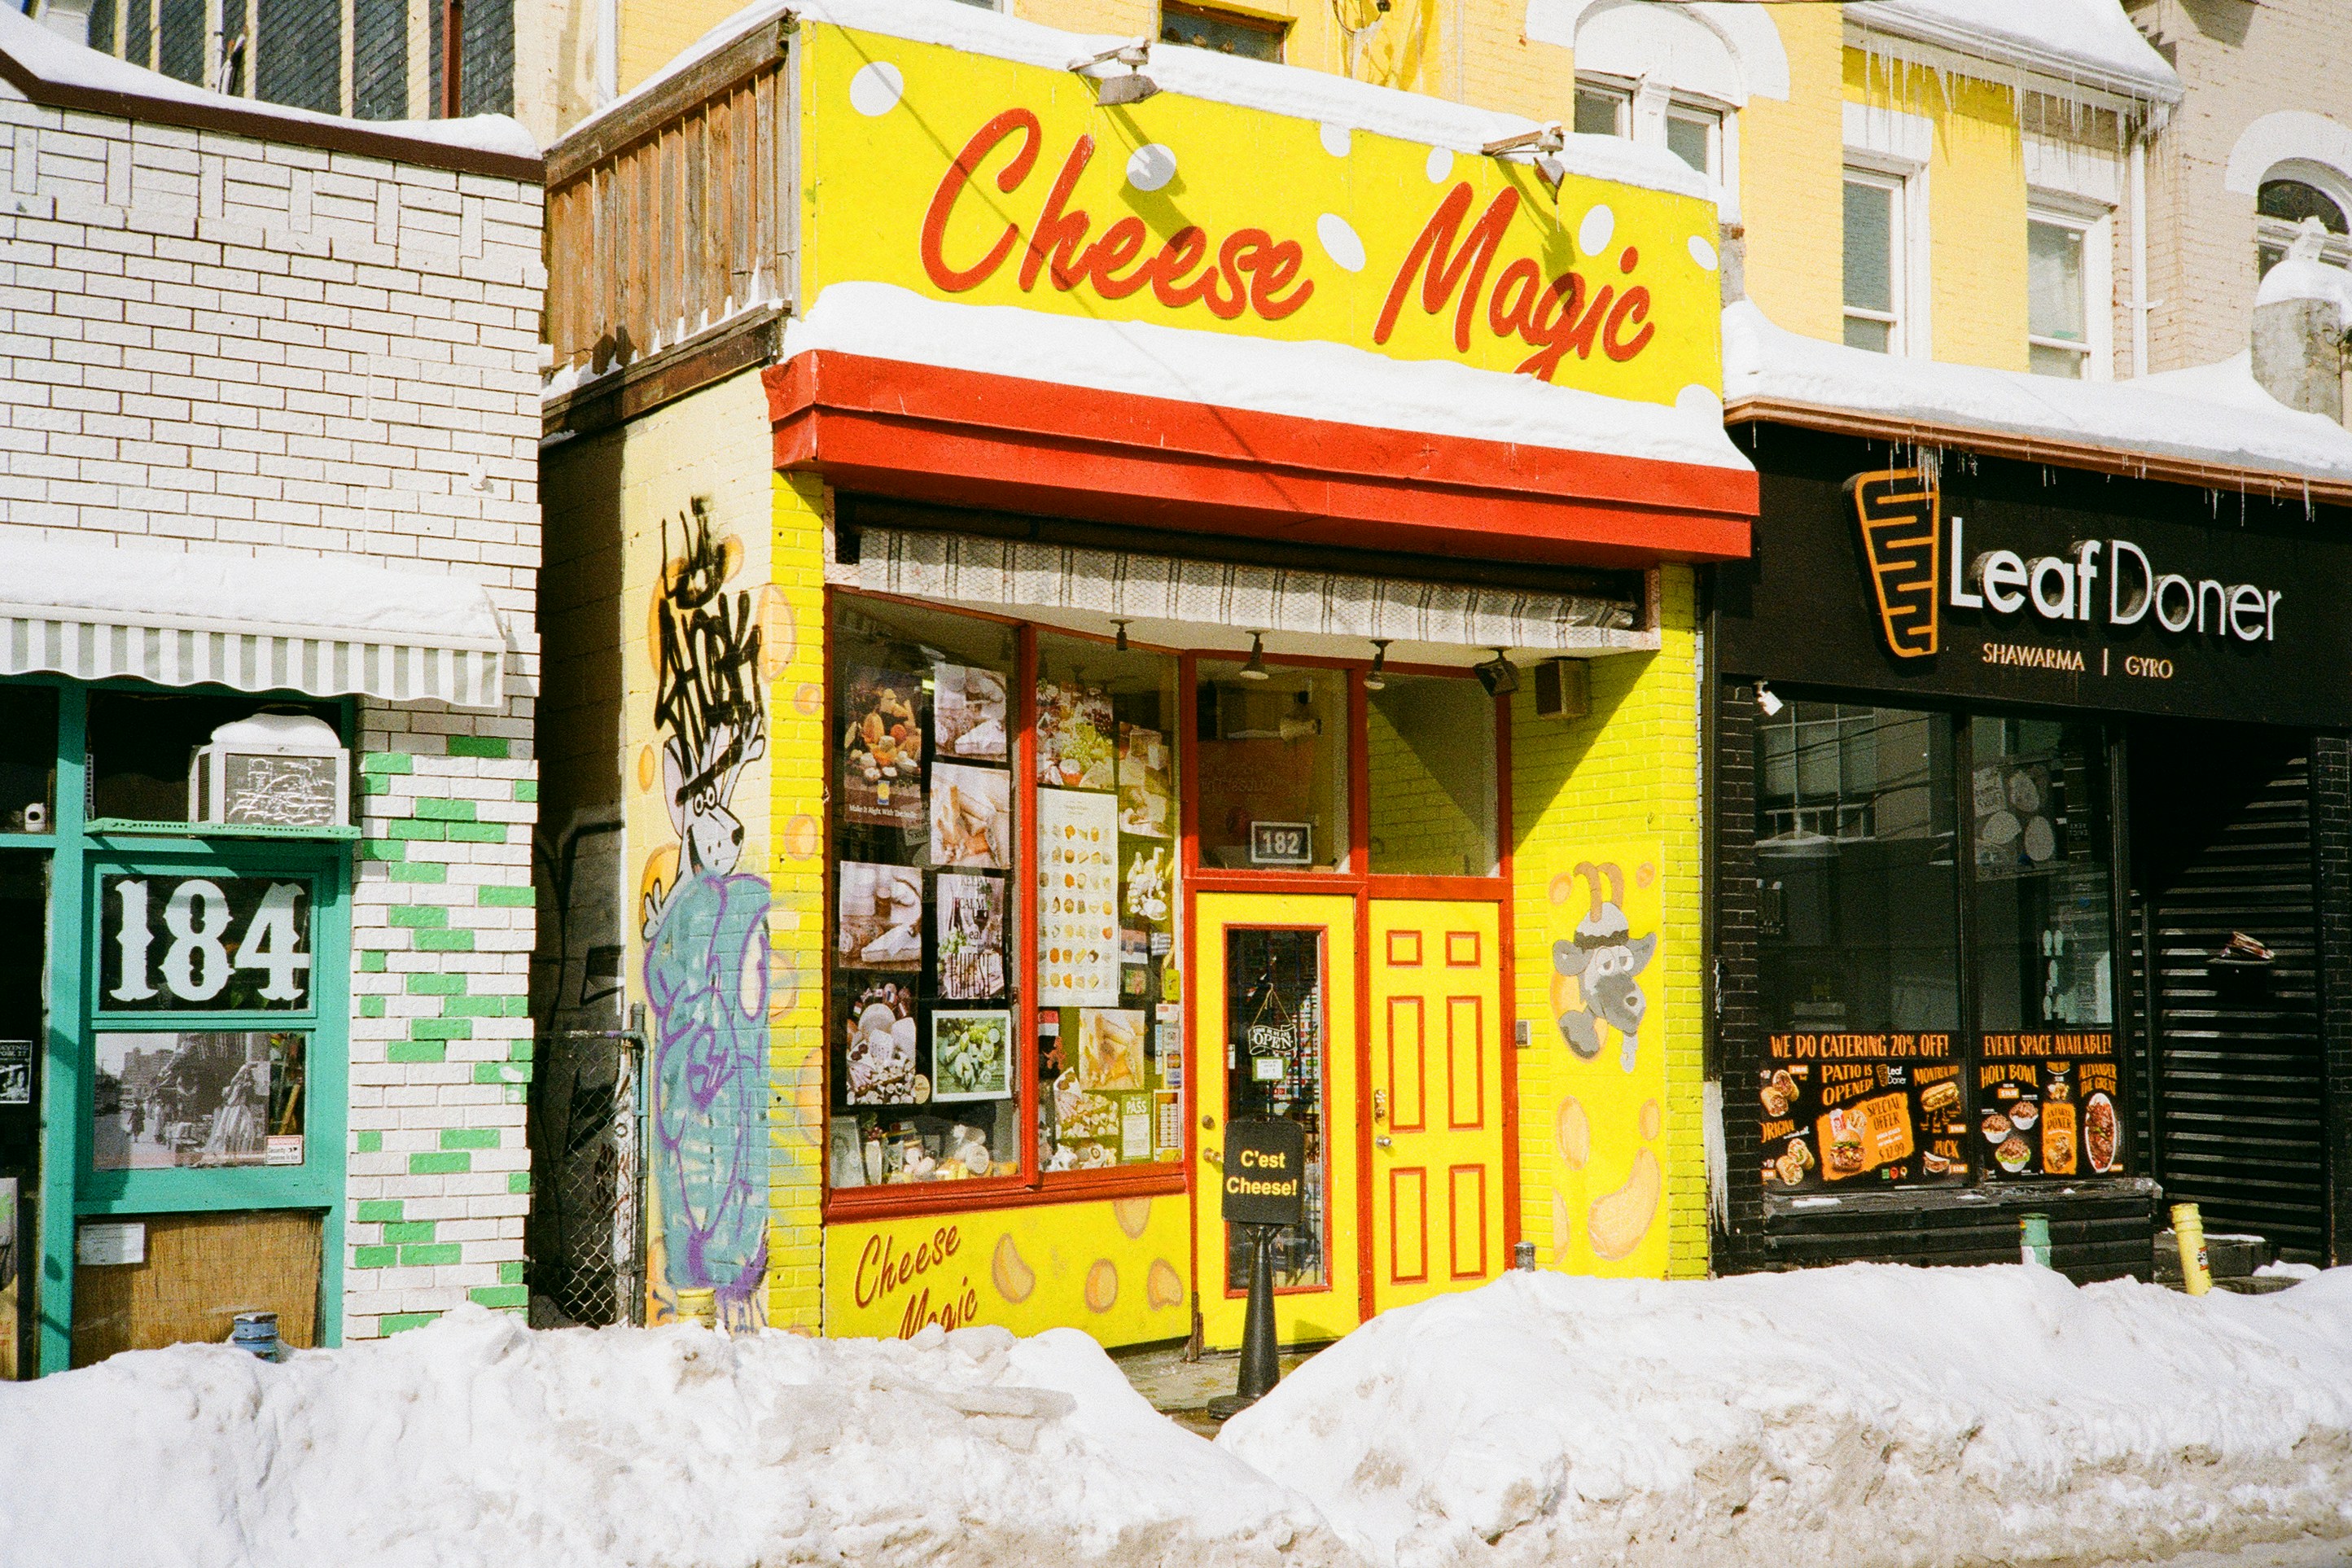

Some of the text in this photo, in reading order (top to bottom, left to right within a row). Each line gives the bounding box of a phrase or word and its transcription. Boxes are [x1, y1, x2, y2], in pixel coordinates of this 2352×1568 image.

[920, 107, 1656, 383] Cheese Magic
[1950, 515, 2282, 642] Leaf Doner
[1982, 642, 2174, 680] SHAWARMA GYRO
[1262, 830, 1300, 855] 182
[960, 875, 983, 887] KEEP
[959, 897, 985, 909] CALM
[108, 878, 310, 1002] 184
[968, 930, 983, 940] eat
[950, 952, 992, 999] CHEESE
[1253, 1032, 1293, 1049] OPEN
[1770, 1034, 1950, 1058] WE DO CATERING 20% OFF!
[1984, 1033, 2113, 1057] EVENT SPACE AVAILABLE!
[1820, 1064, 1863, 1084] PATIO
[1864, 1064, 1873, 1077] IS
[1886, 1066, 1903, 1075] Leaf
[1887, 1075, 1907, 1085] Doner
[1980, 1065, 2006, 1089] HOLY
[2008, 1064, 2039, 1088] BOWL
[1822, 1079, 1874, 1106] OPENED!
[2080, 1078, 2094, 1097] THE
[1126, 1100, 1148, 1115] PASS
[1866, 1097, 1900, 1118] SPECIAL
[1873, 1111, 1900, 1131] OFFER
[1240, 1149, 1286, 1169] C'est
[1225, 1176, 1298, 1197] Cheese!
[855, 1224, 961, 1309] Cheese
